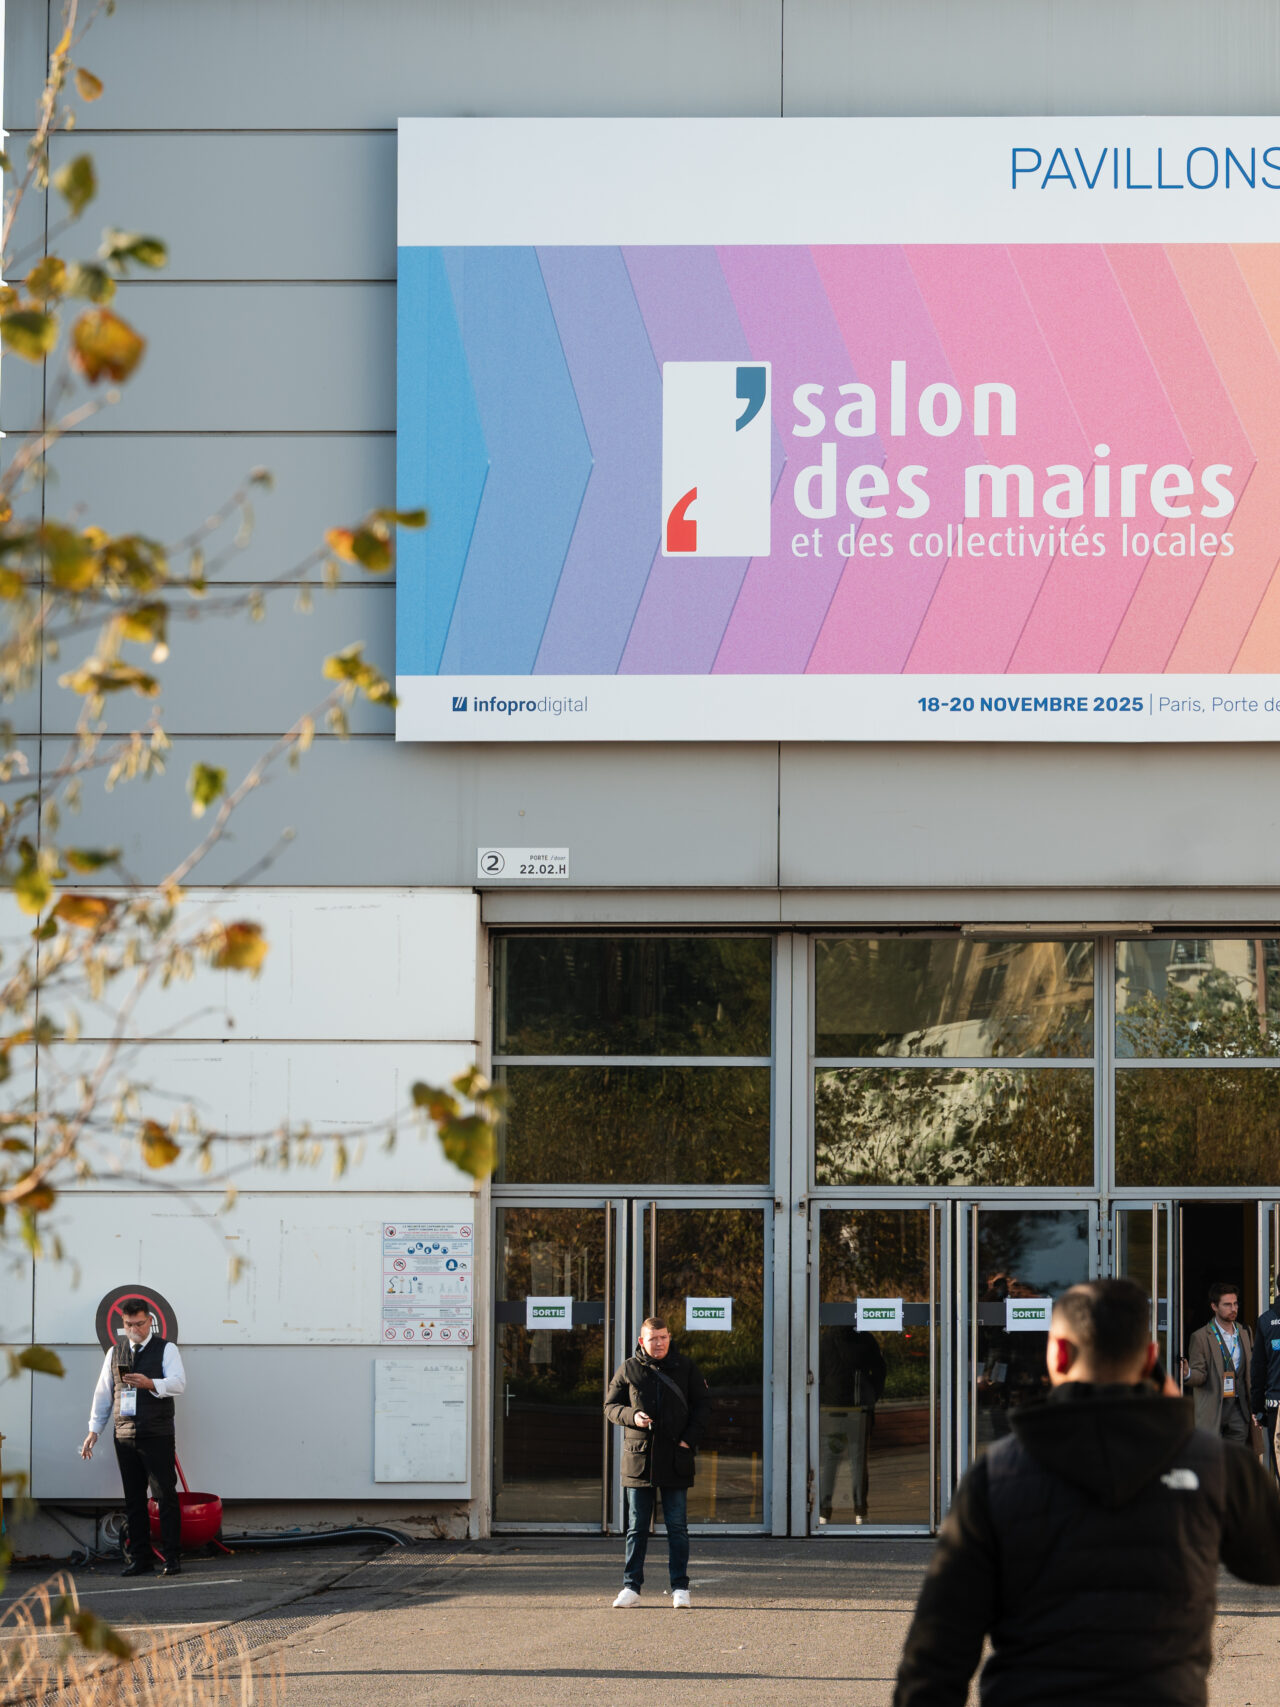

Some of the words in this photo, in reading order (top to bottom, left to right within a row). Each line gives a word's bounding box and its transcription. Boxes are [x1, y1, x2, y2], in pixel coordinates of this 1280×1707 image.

[791, 360, 1018, 438] salon
[793, 442, 931, 519] des
[964, 443, 1235, 519] maires
[791, 527, 823, 557] et
[837, 524, 894, 557] des
[909, 523, 1106, 558] collectivités
[1122, 523, 1235, 557] locales
[473, 696, 588, 716] infoprodigital
[917, 696, 975, 712] 18-20
[980, 696, 1089, 712] NOVEMBRE
[1092, 696, 1144, 712] 2025
[1159, 696, 1206, 713] Paris,
[1212, 696, 1259, 712] Porte
[486, 855, 499, 871] 2
[519, 864, 566, 875] 22.02.H
[532, 1308, 566, 1318] SORTIE
[691, 1309, 726, 1319] SORTIE
[862, 1310, 897, 1319] SORTIE
[1012, 1310, 1046, 1319] SORTIE
